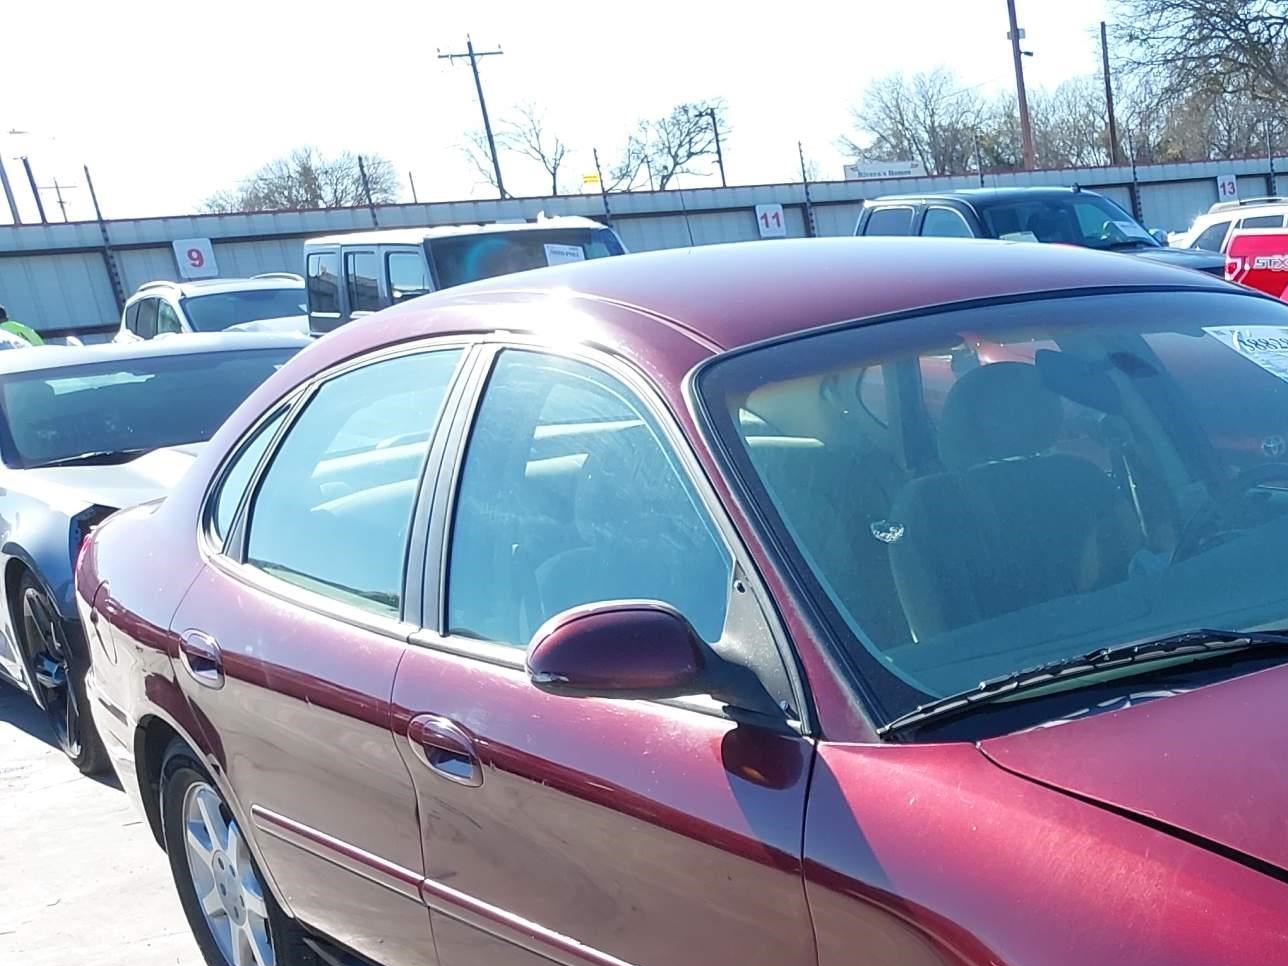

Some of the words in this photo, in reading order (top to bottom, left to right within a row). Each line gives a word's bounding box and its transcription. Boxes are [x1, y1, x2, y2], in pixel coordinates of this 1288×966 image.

[1220, 181, 1236, 196] 13
[760, 211, 781, 229] 11
[187, 248, 204, 268] 9
